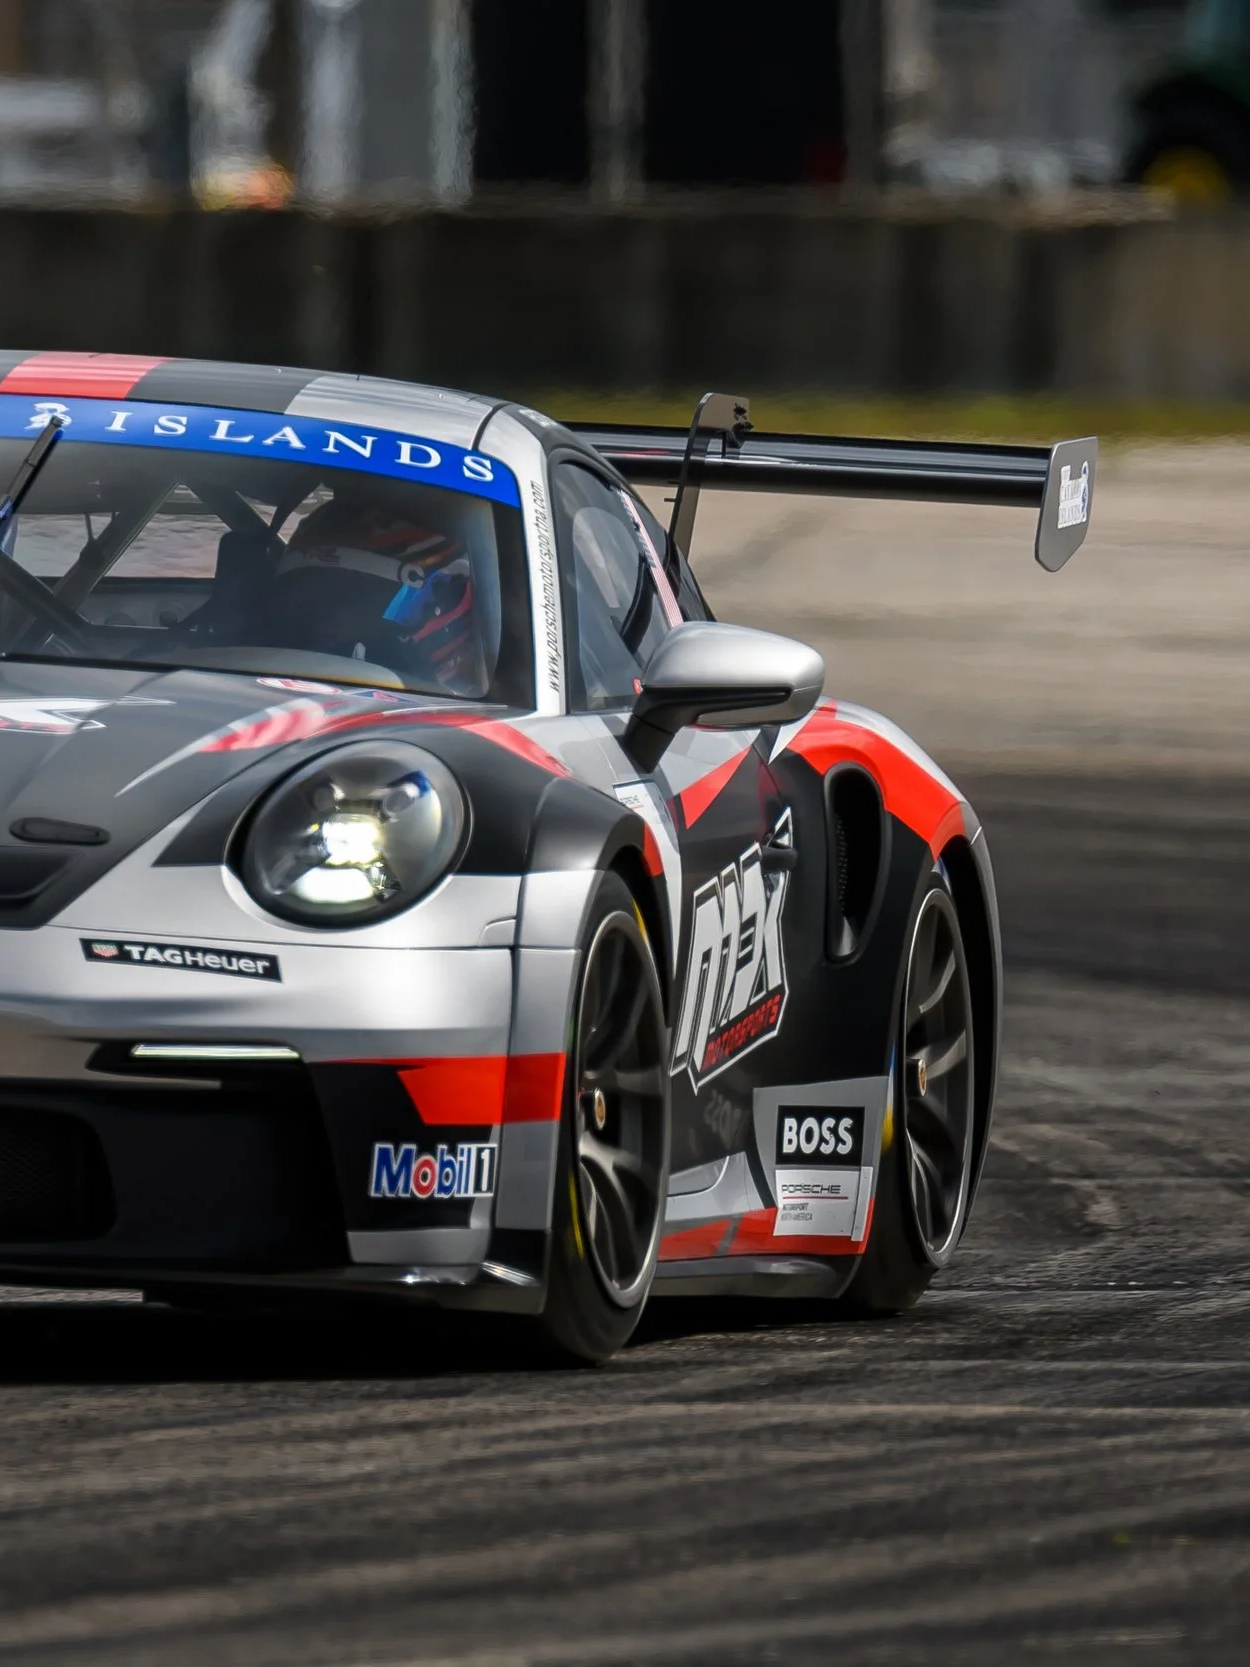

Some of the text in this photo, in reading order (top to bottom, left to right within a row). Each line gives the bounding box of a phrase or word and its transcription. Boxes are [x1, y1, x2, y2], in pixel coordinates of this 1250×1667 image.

[105, 411, 494, 482] ISLANDS
[530, 480, 561, 692] www.porschemotorsportna.com
[782, 1117, 853, 1154] BOSS
[781, 1184, 841, 1194] PORSCHE
